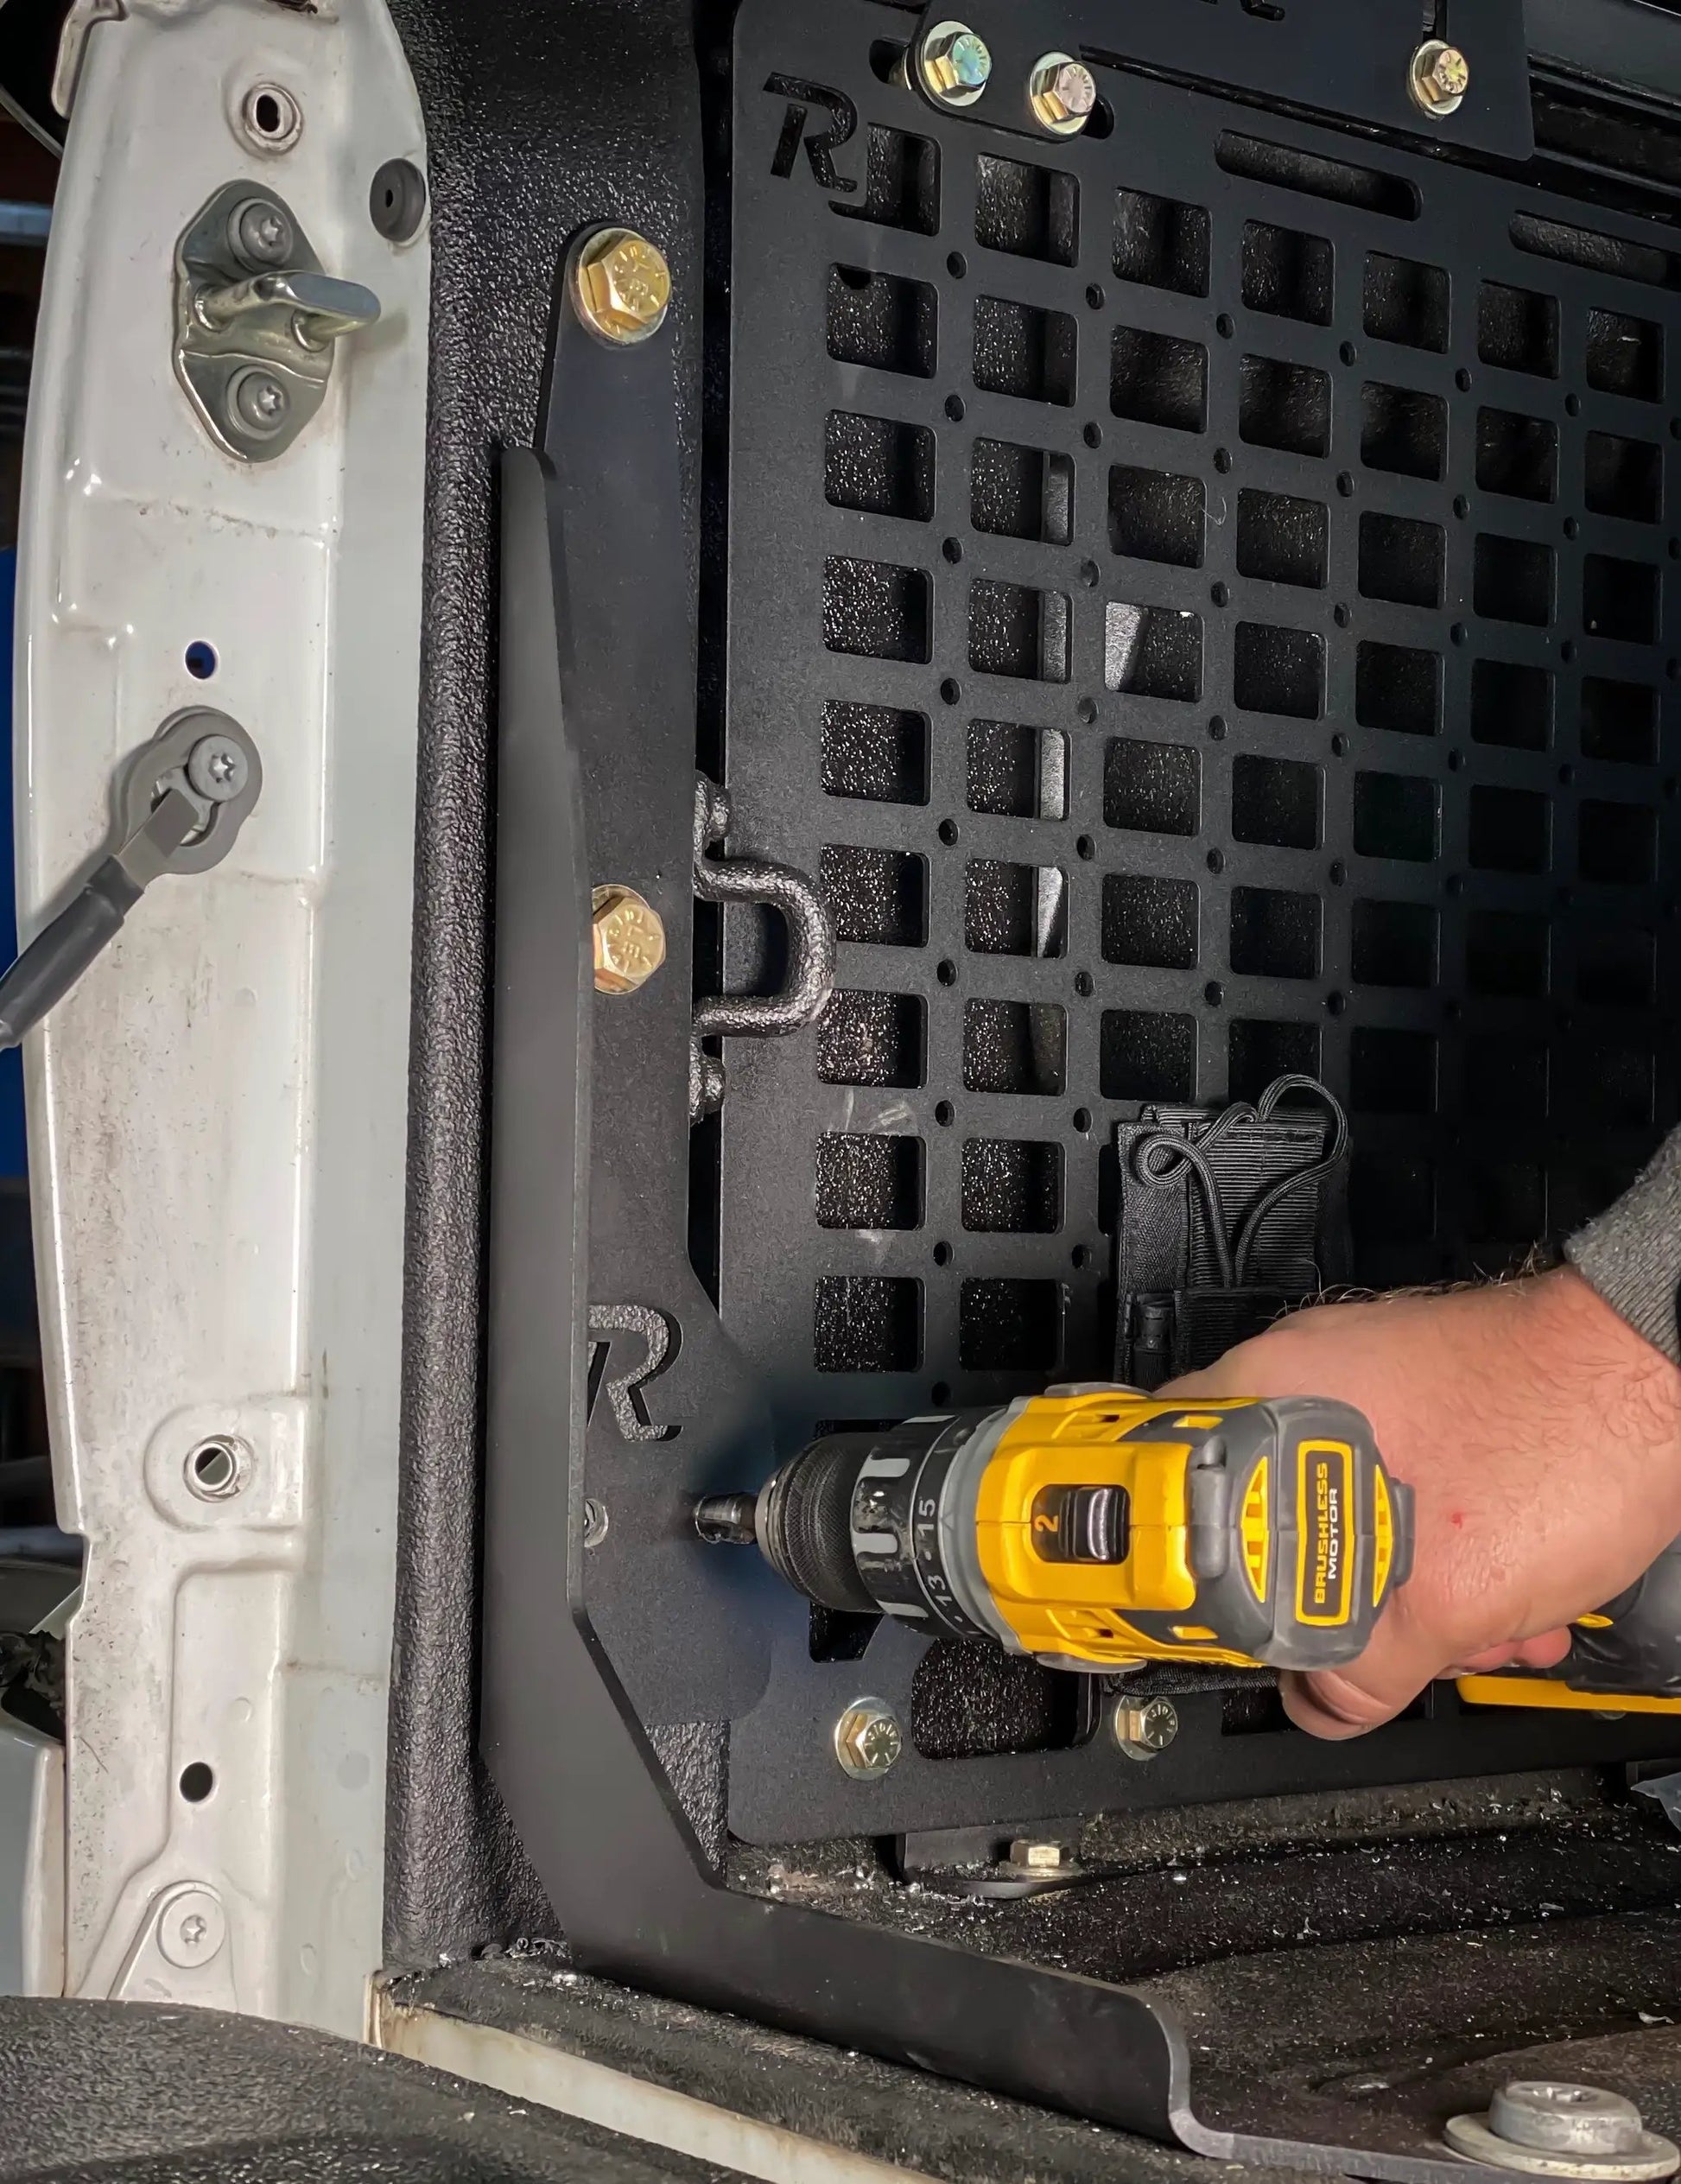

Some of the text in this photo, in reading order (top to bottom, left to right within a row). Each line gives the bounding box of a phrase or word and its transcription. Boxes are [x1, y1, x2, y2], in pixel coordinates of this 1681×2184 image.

[917, 1497, 953, 1608] 13 15
[1034, 1514, 1060, 1533] 2
[1314, 1462, 1329, 1604] BRUSHLESS
[1327, 1488, 1340, 1580] MOTOR
